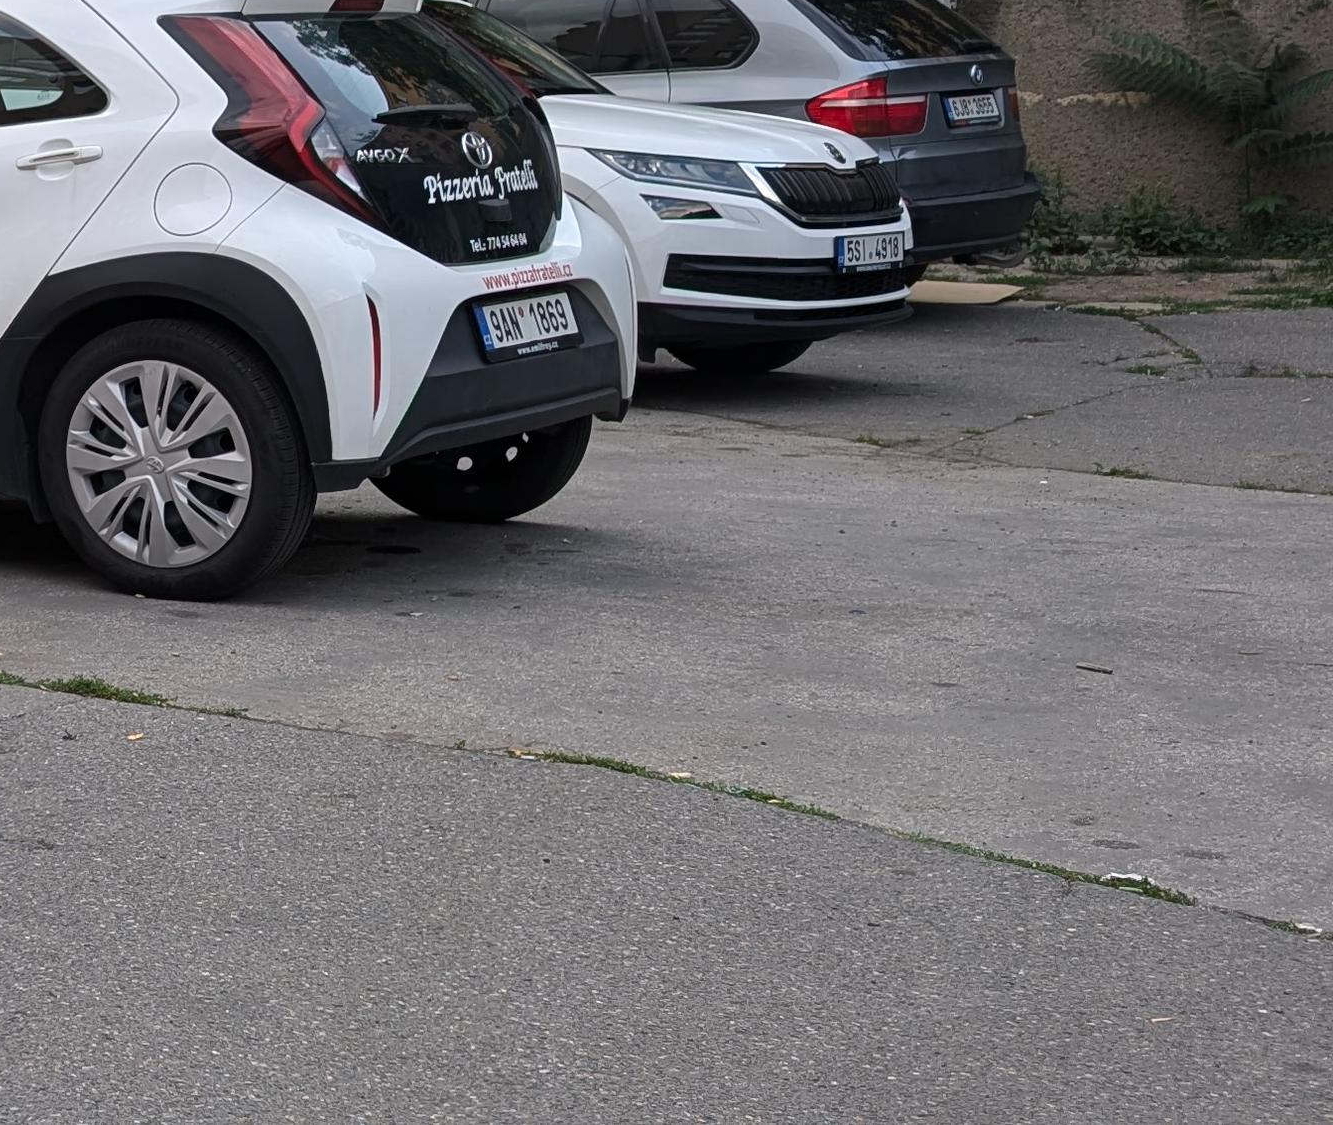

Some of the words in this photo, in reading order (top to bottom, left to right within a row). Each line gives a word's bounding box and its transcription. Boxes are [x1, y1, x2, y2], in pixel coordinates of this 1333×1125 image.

[356, 148, 394, 164] AYGO
[424, 169, 495, 204] Pizzeria
[495, 158, 539, 200] Fratelli
[469, 238, 486, 252] Tel.:
[487, 236, 502, 250] 774
[502, 235, 510, 248] 54
[510, 234, 519, 247] 64
[519, 232, 528, 246] 04
[847, 239, 866, 263] 5SI
[876, 236, 899, 260] 4918
[482, 261, 573, 291] www.pizzafratelli.cz
[489, 307, 524, 343] 9AN
[528, 298, 569, 336] 1869
